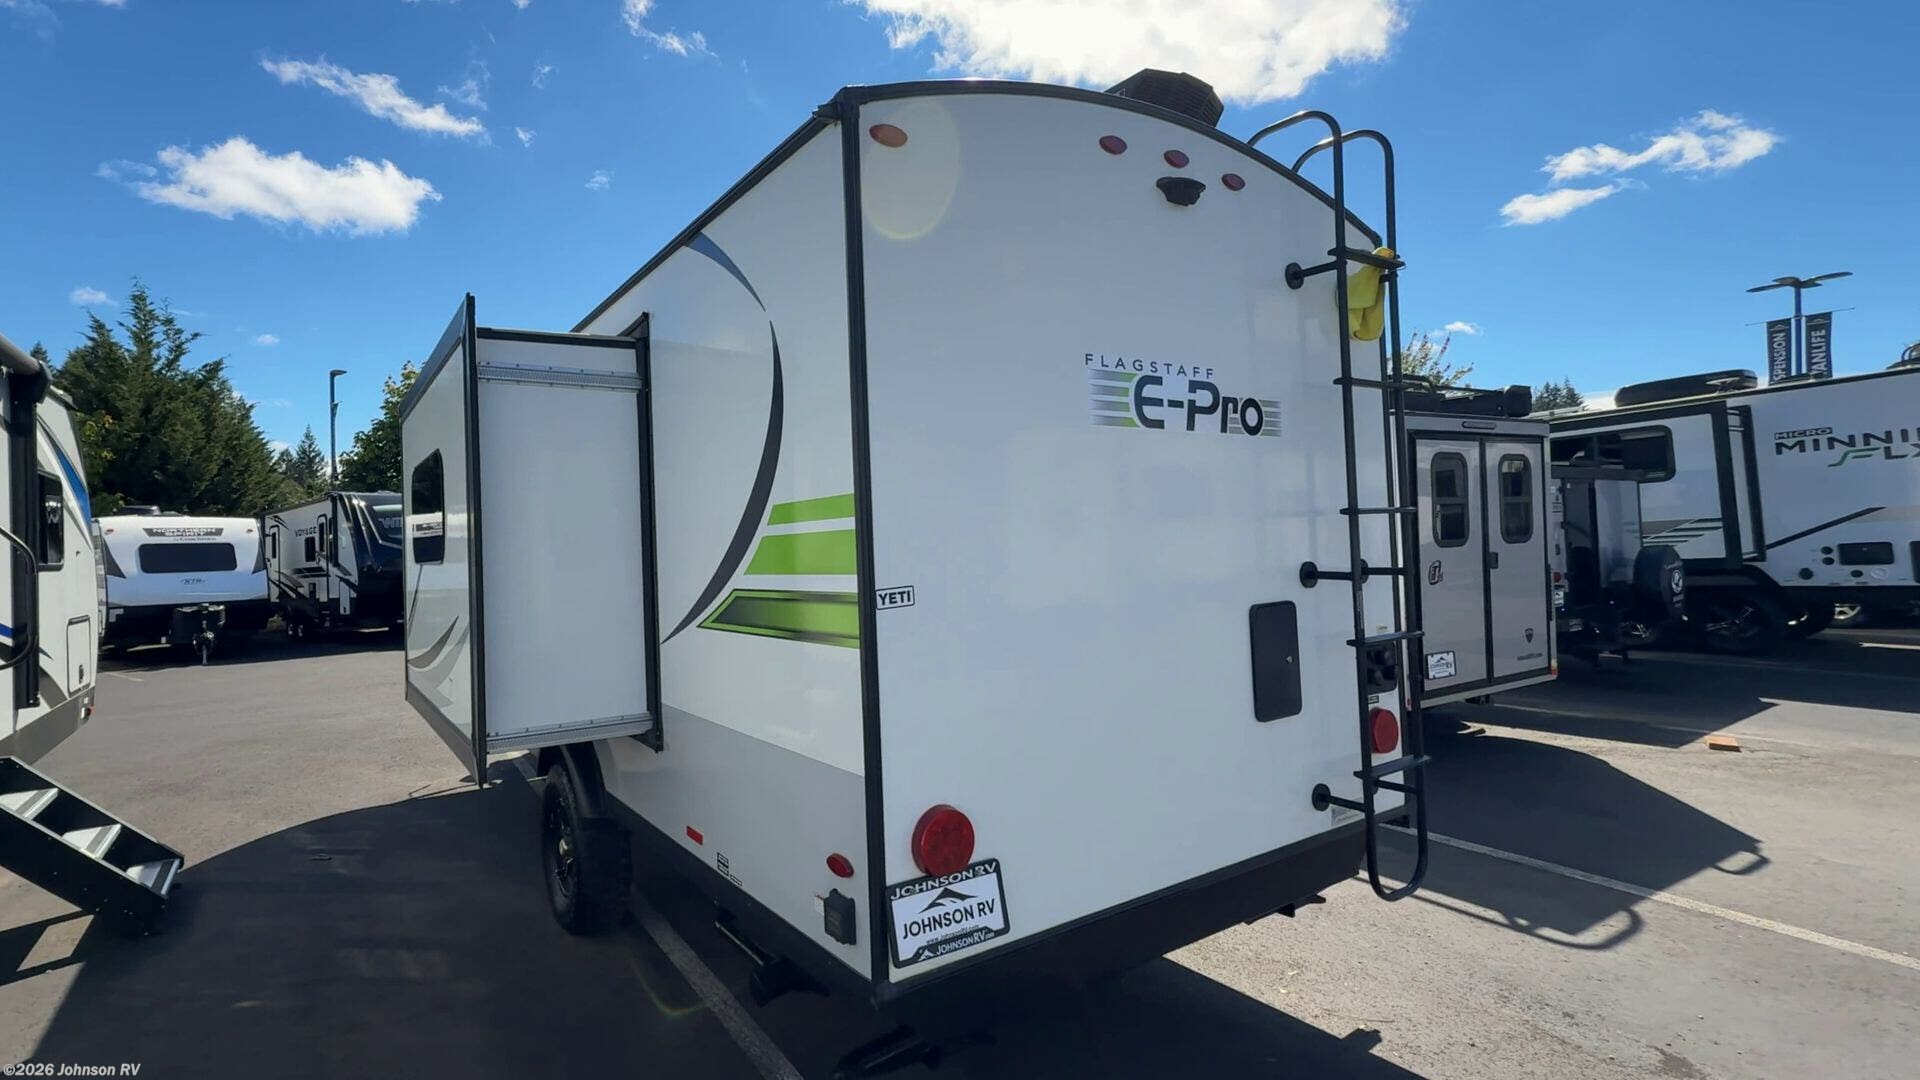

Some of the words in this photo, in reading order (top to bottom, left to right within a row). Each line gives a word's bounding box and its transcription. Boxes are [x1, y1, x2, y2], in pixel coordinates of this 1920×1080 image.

[1085, 353, 1214, 379] FLAGSTAFF
[1133, 374, 1265, 437] E-Pro
[1775, 427, 1832, 440] MICRO
[1775, 427, 1920, 455] MINNI
[878, 590, 911, 606] YETI
[903, 905, 975, 940] JOHNSON
[977, 898, 996, 917] RV
